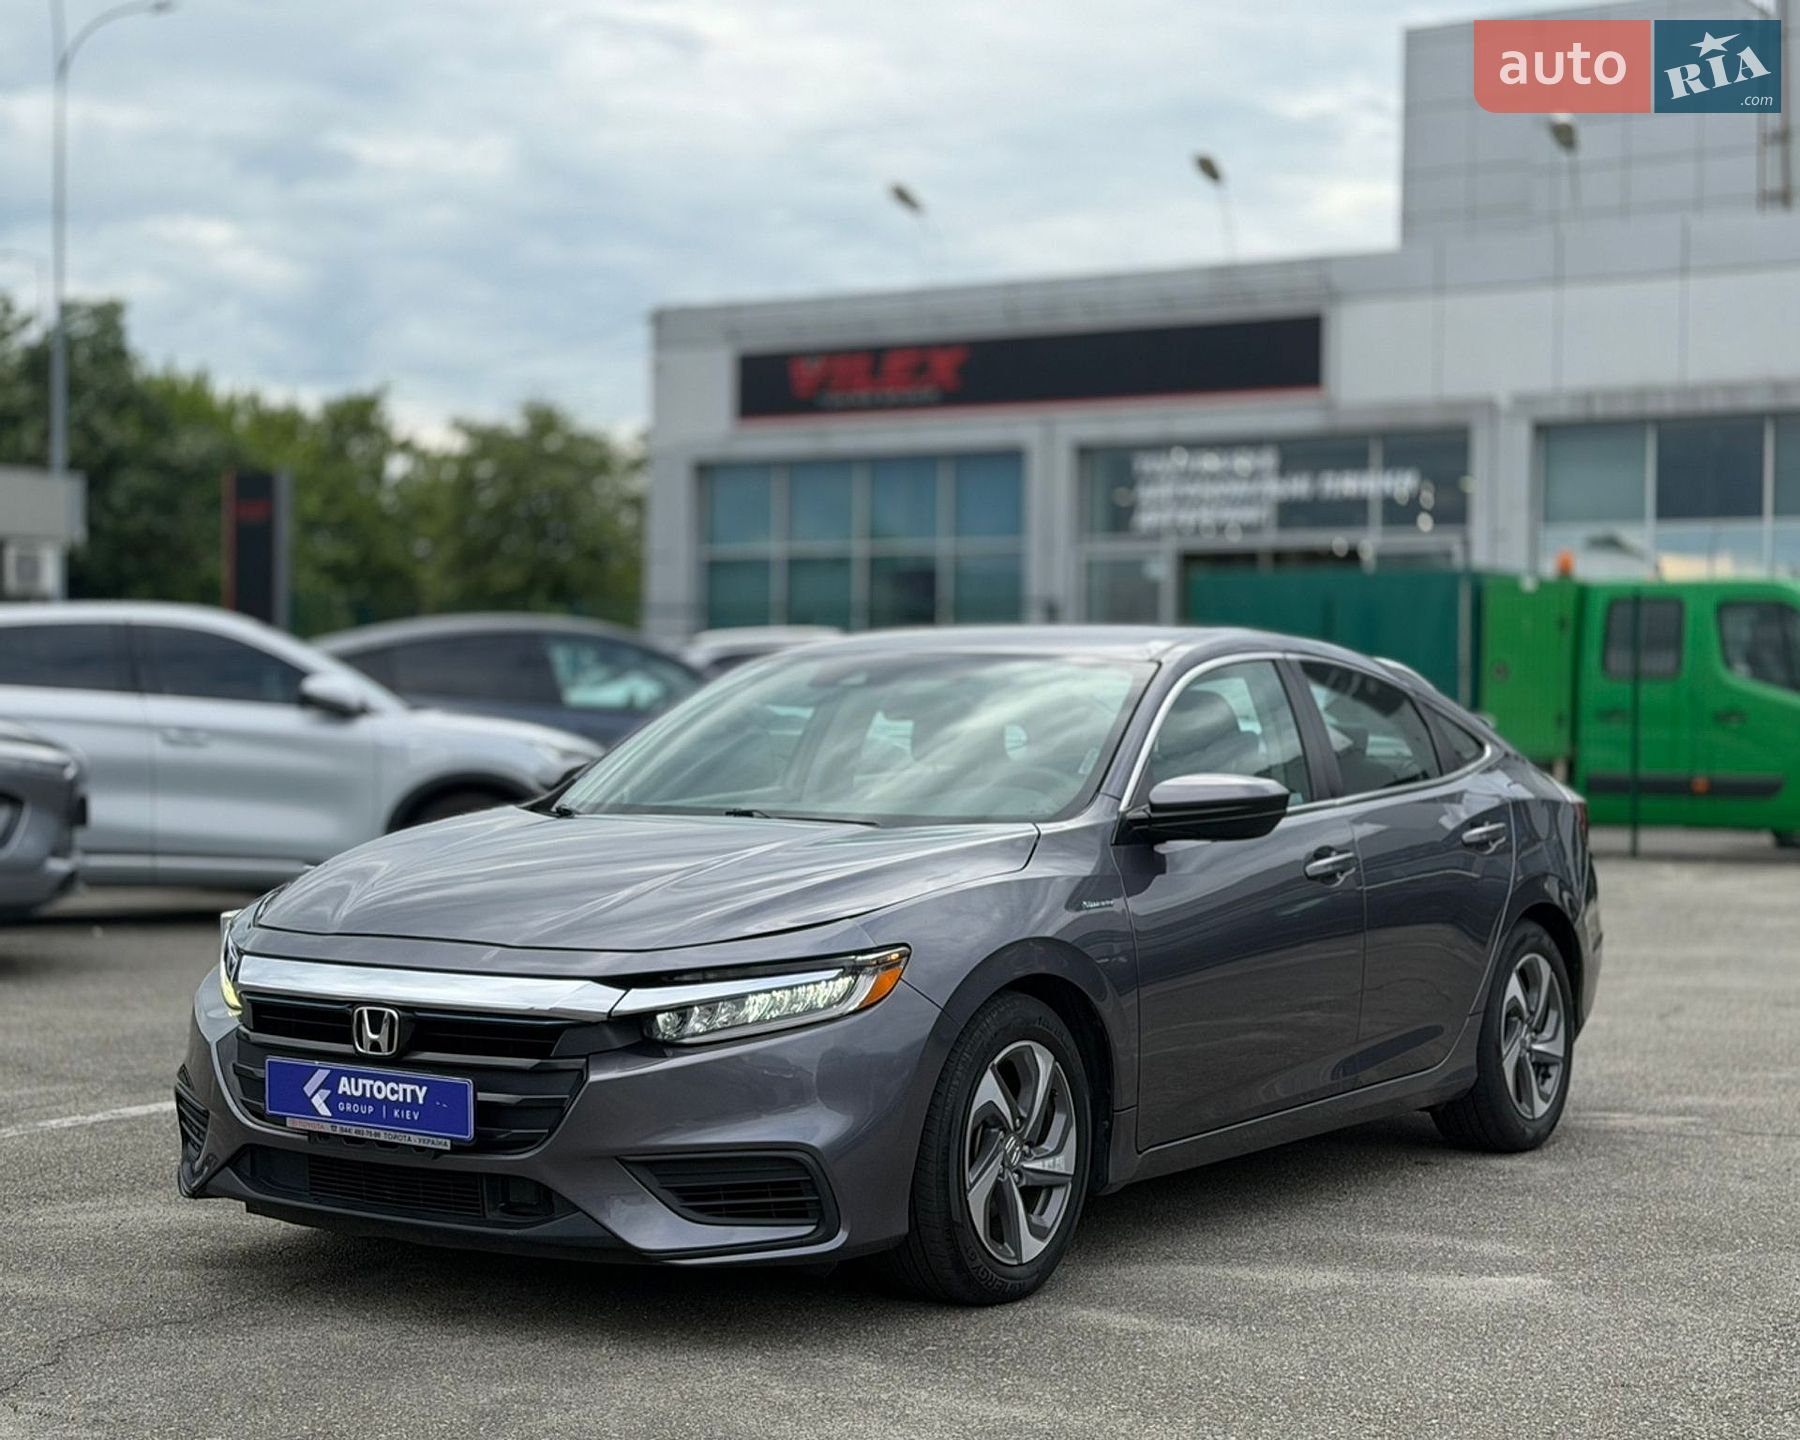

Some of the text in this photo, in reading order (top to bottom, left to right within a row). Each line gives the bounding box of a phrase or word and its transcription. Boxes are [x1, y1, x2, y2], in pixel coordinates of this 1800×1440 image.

[338, 1076, 428, 1104] AUTOCITY
[338, 1102, 420, 1120] GROUP KIEV
